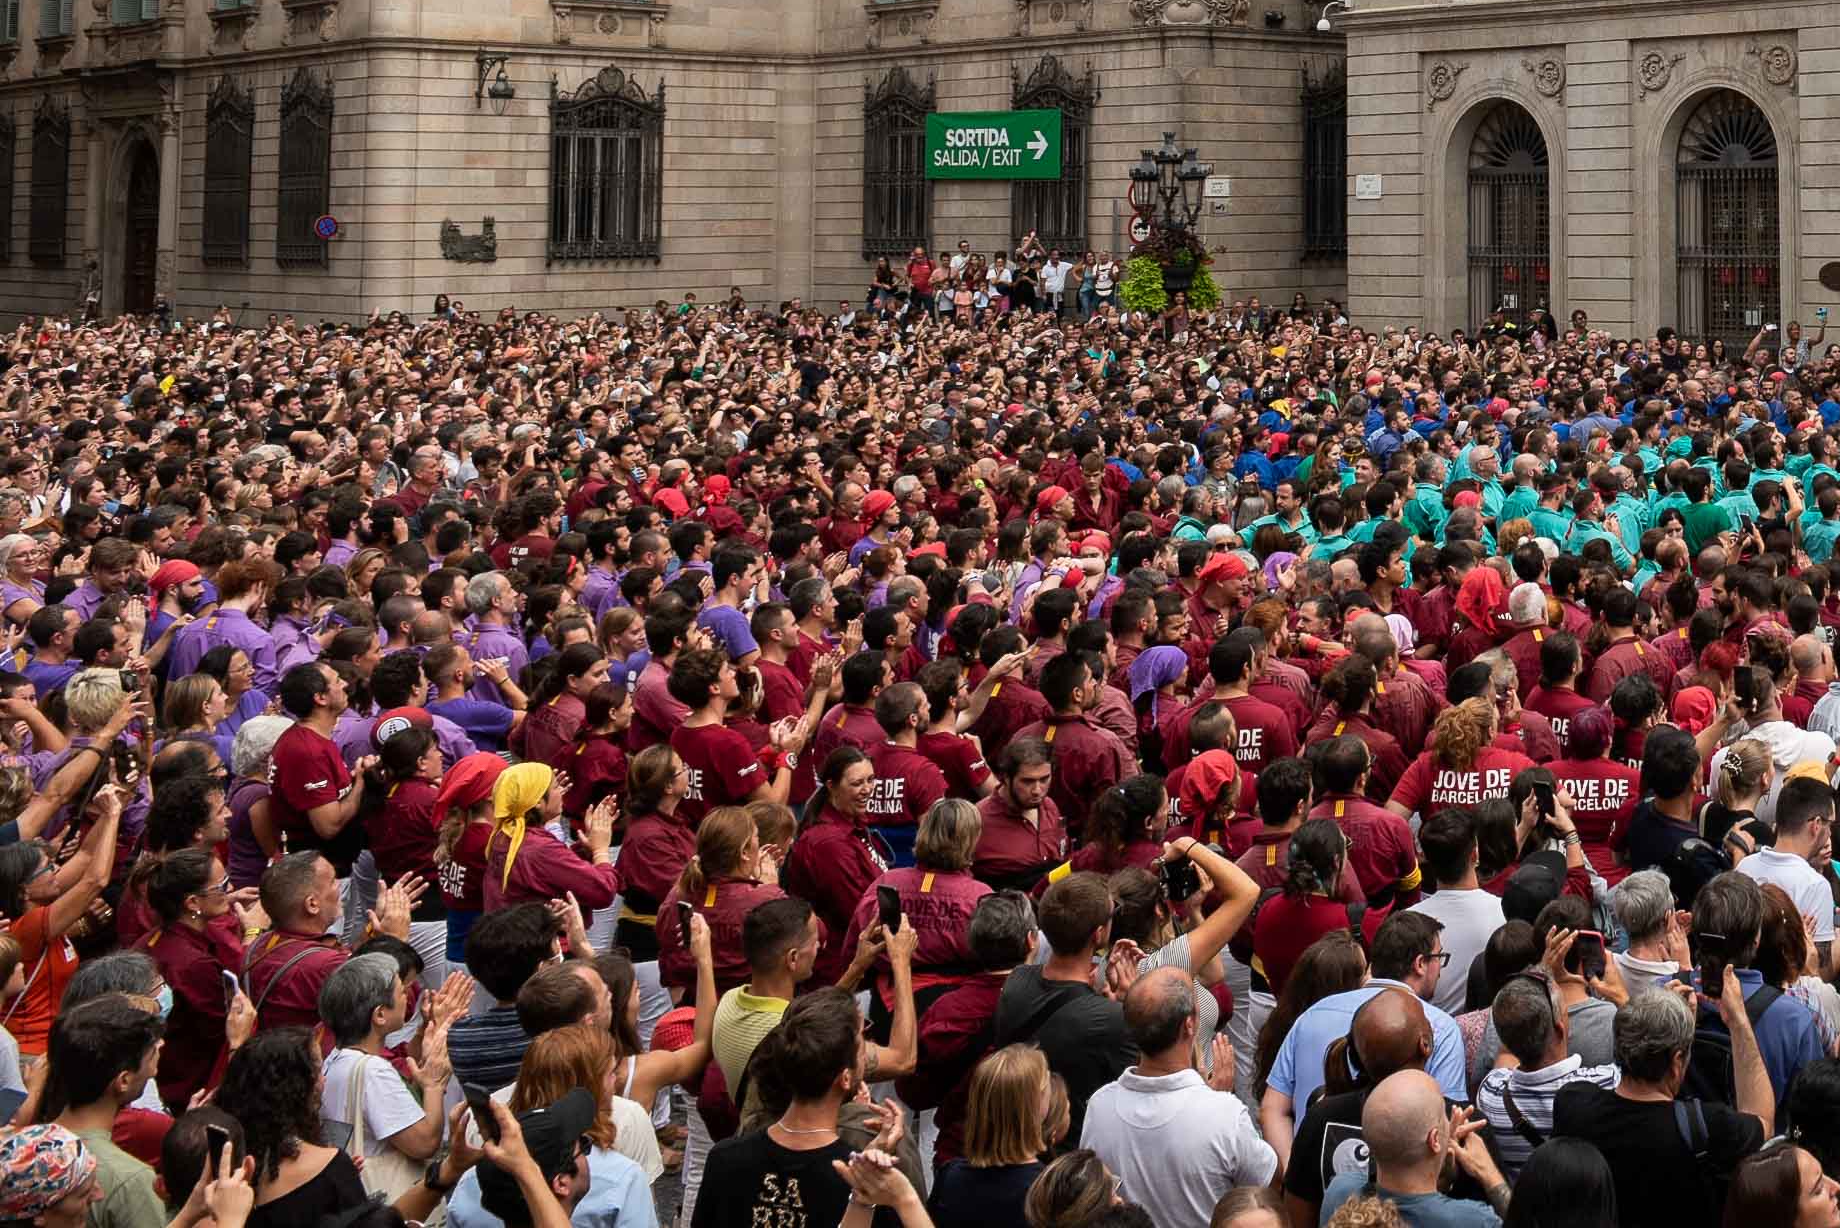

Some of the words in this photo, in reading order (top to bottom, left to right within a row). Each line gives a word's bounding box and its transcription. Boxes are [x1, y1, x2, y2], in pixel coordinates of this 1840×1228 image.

[945, 128, 1009, 147] SORTIDA
[934, 149, 981, 166] SALIDA
[992, 148, 1022, 166] EXIT
[1552, 717, 1570, 735] DE
[1239, 728, 1263, 747] DE
[885, 778, 905, 798] DE
[1434, 770, 1480, 790] JOVE
[1486, 768, 1511, 788] DE
[1558, 778, 1600, 798] OVE
[1604, 778, 1629, 797] DE
[1431, 787, 1510, 805] BARCELONA
